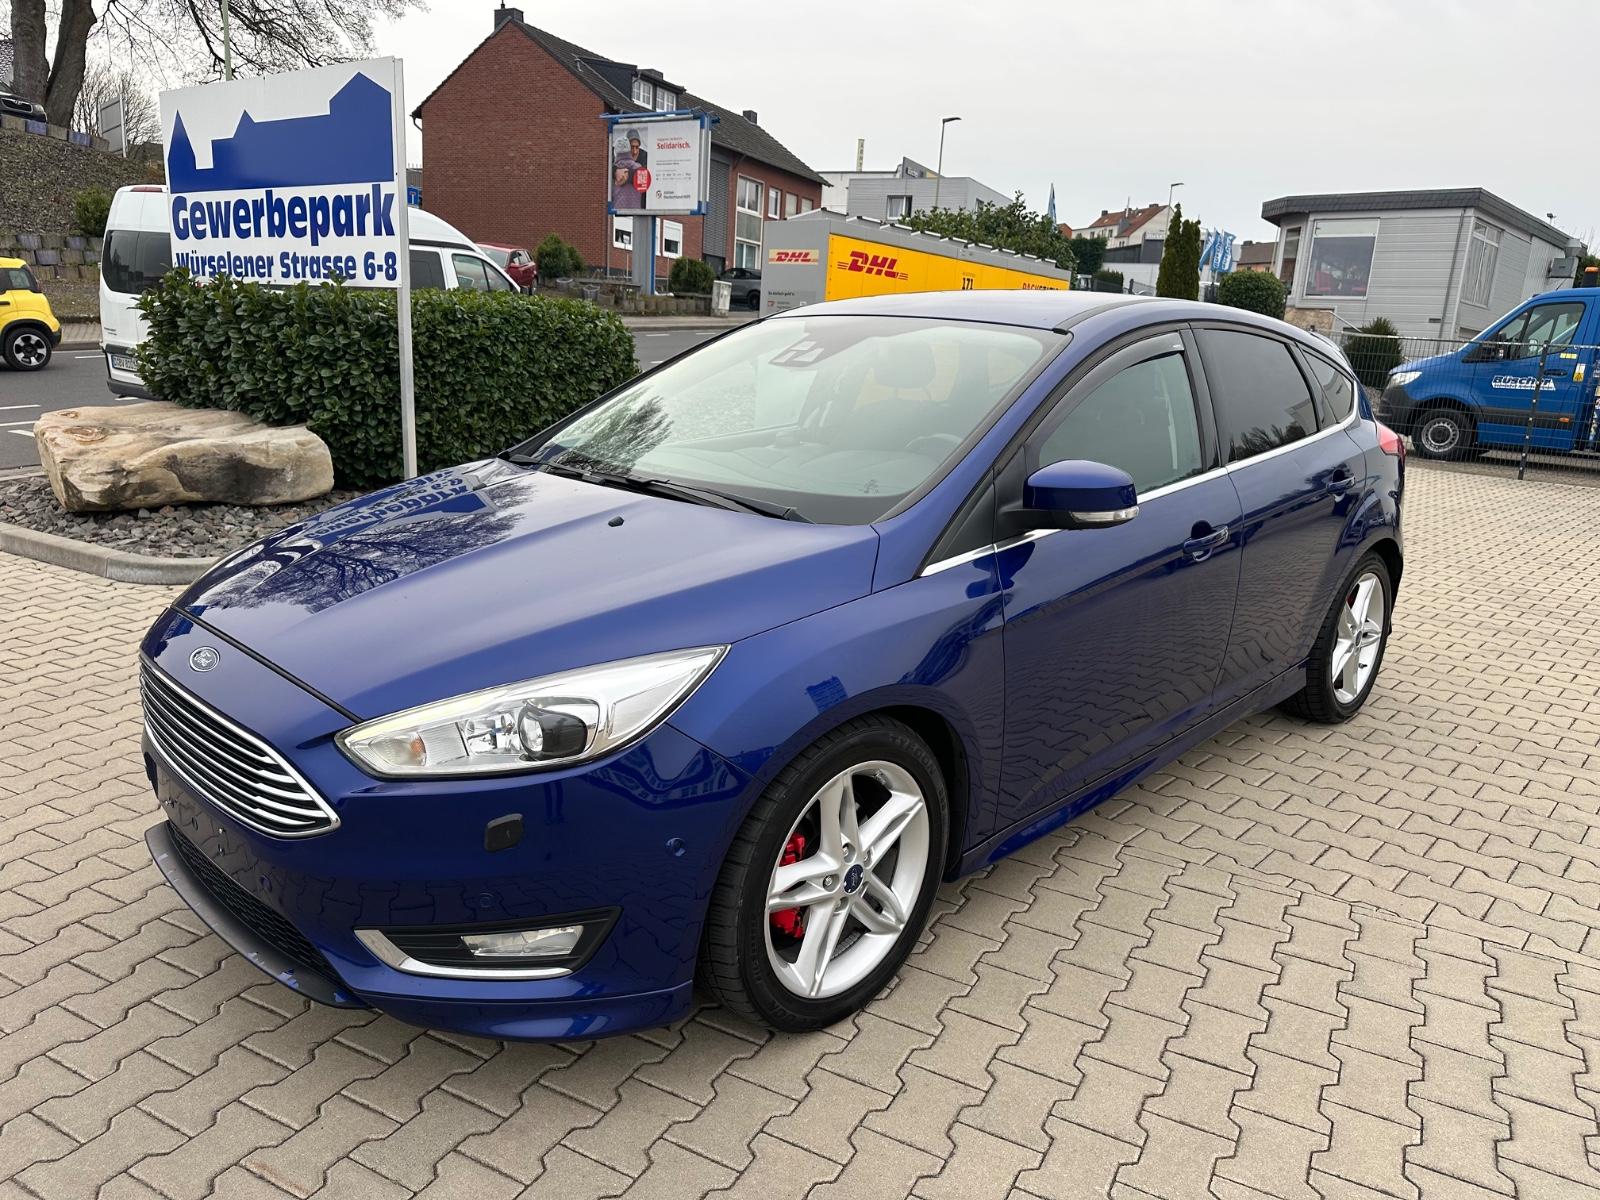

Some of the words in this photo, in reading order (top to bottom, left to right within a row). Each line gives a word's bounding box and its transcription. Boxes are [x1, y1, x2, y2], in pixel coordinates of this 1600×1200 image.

[172, 183, 396, 247] Gewerbepark
[175, 250, 274, 278] Würselener
[279, 250, 357, 280] Strasse
[363, 251, 398, 281] 6-8
[776, 251, 812, 263] DHL
[847, 250, 900, 279] DHL
[962, 277, 974, 290] 171
